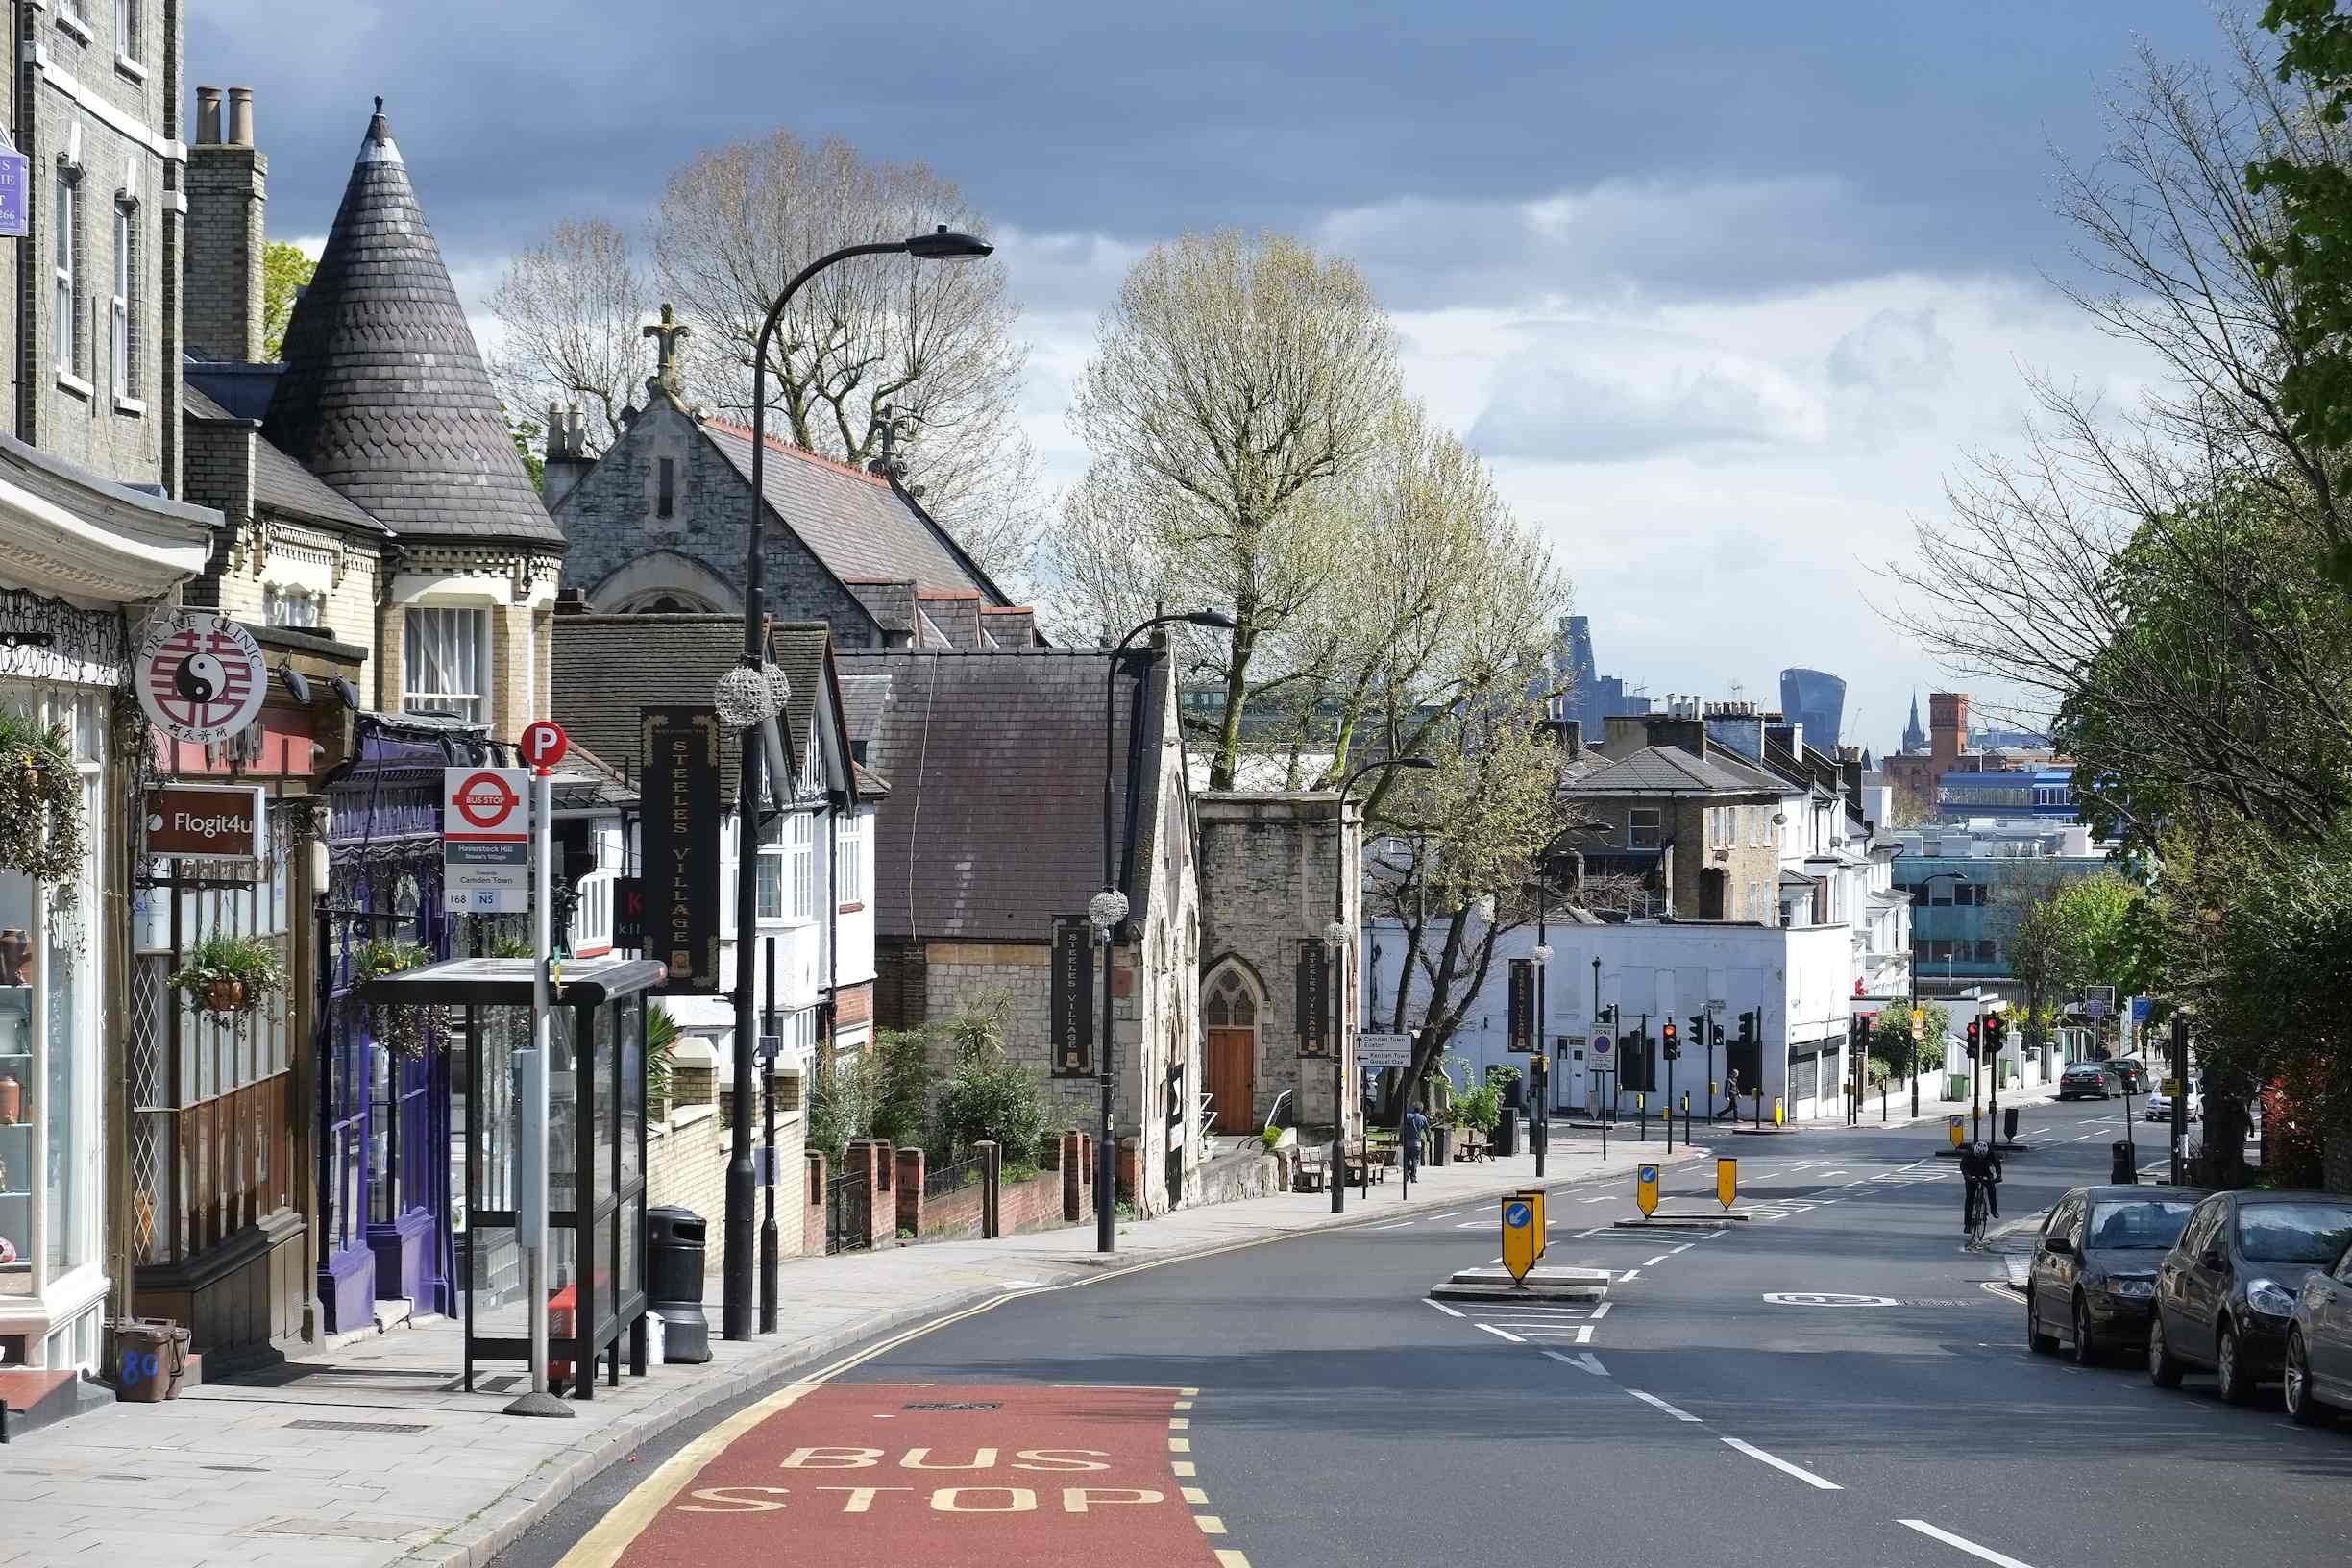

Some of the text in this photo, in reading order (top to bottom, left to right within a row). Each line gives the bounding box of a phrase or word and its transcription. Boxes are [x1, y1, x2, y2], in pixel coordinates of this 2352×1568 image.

[211, 617, 263, 670] CLINIC
[534, 727, 558, 760] P
[465, 796, 505, 804] BUS STOP
[174, 812, 253, 838] Flogit4u
[672, 740, 691, 943] STEELES VILLAGE
[460, 876, 514, 885] Camden Town
[450, 894, 468, 905] 168
[478, 894, 493, 905] N5
[1067, 933, 1077, 1049] STEELES VILLAGE
[122, 1351, 159, 1384] 80
[779, 1446, 1112, 1472] BUS
[674, 1486, 1165, 1513] STOP
